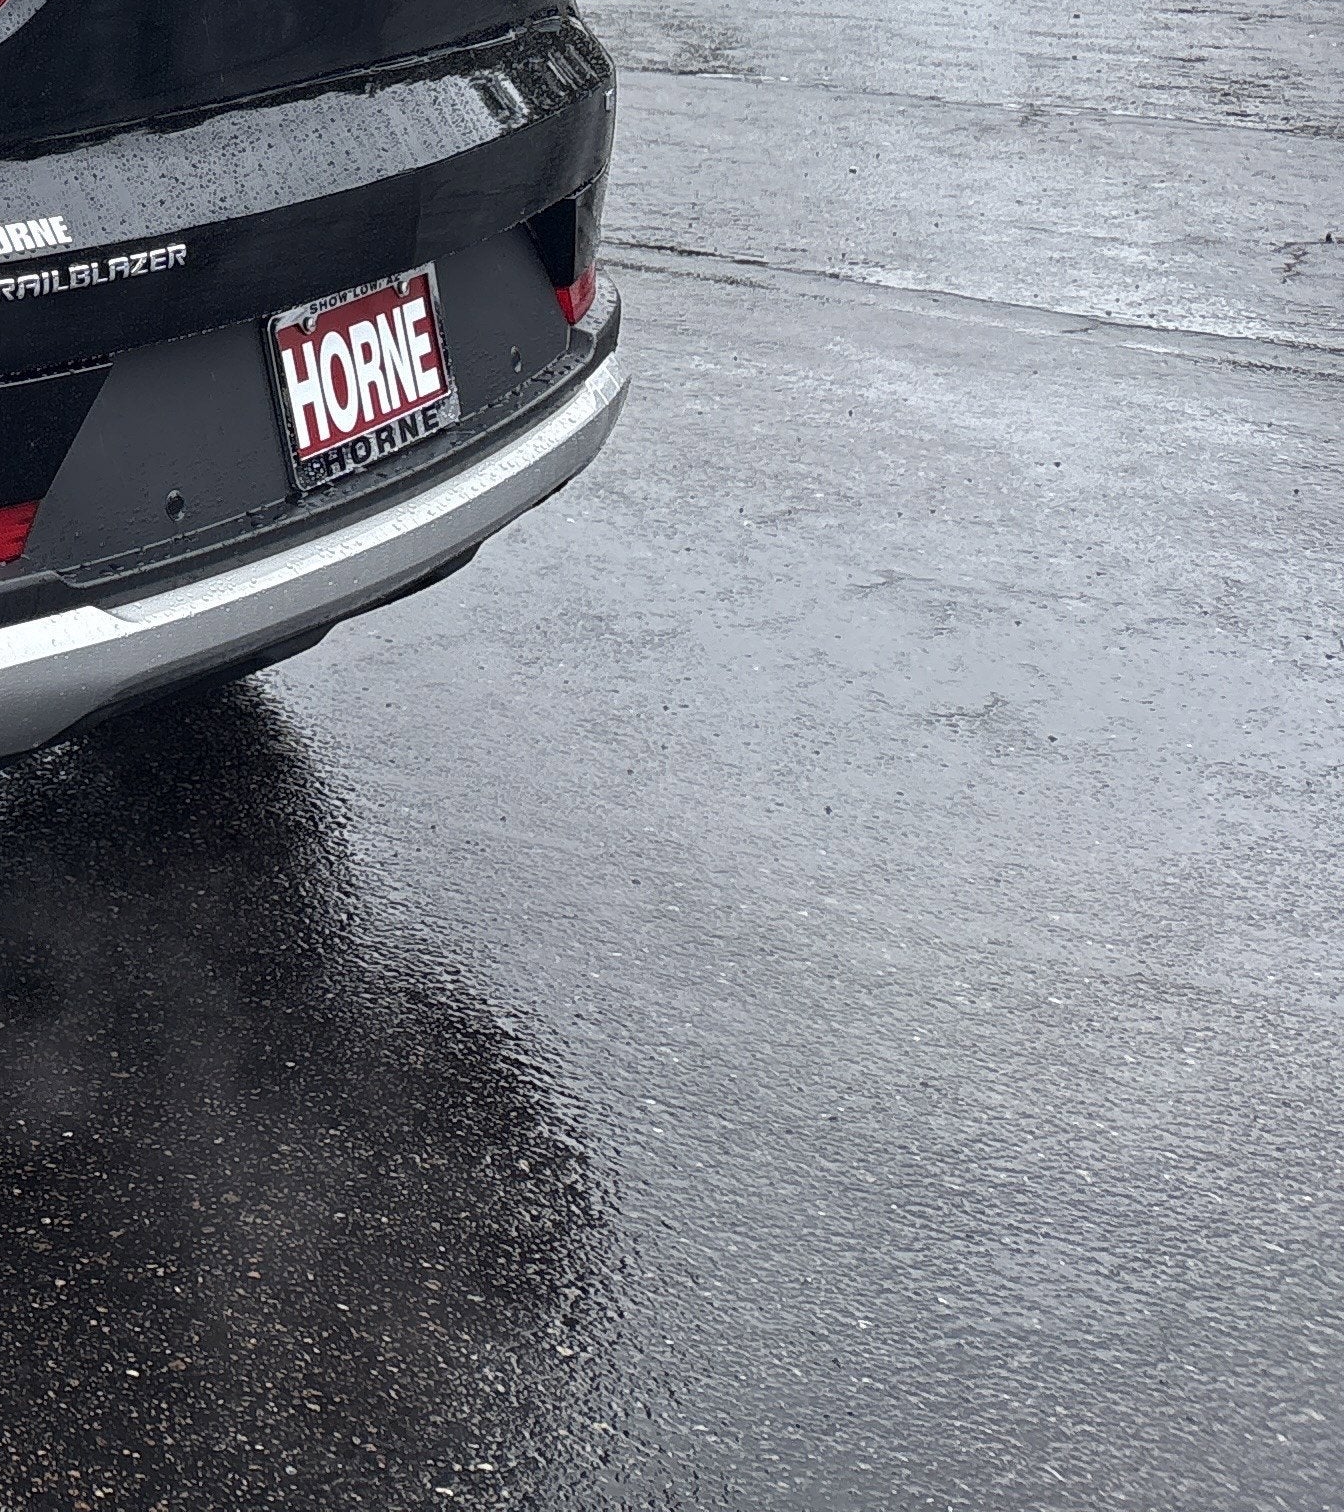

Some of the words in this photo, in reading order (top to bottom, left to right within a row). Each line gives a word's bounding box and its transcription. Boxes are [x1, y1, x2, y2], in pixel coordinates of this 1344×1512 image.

[309, 291, 348, 315] SHOW
[281, 296, 441, 450] HORNE
[323, 404, 440, 476] HORNE
